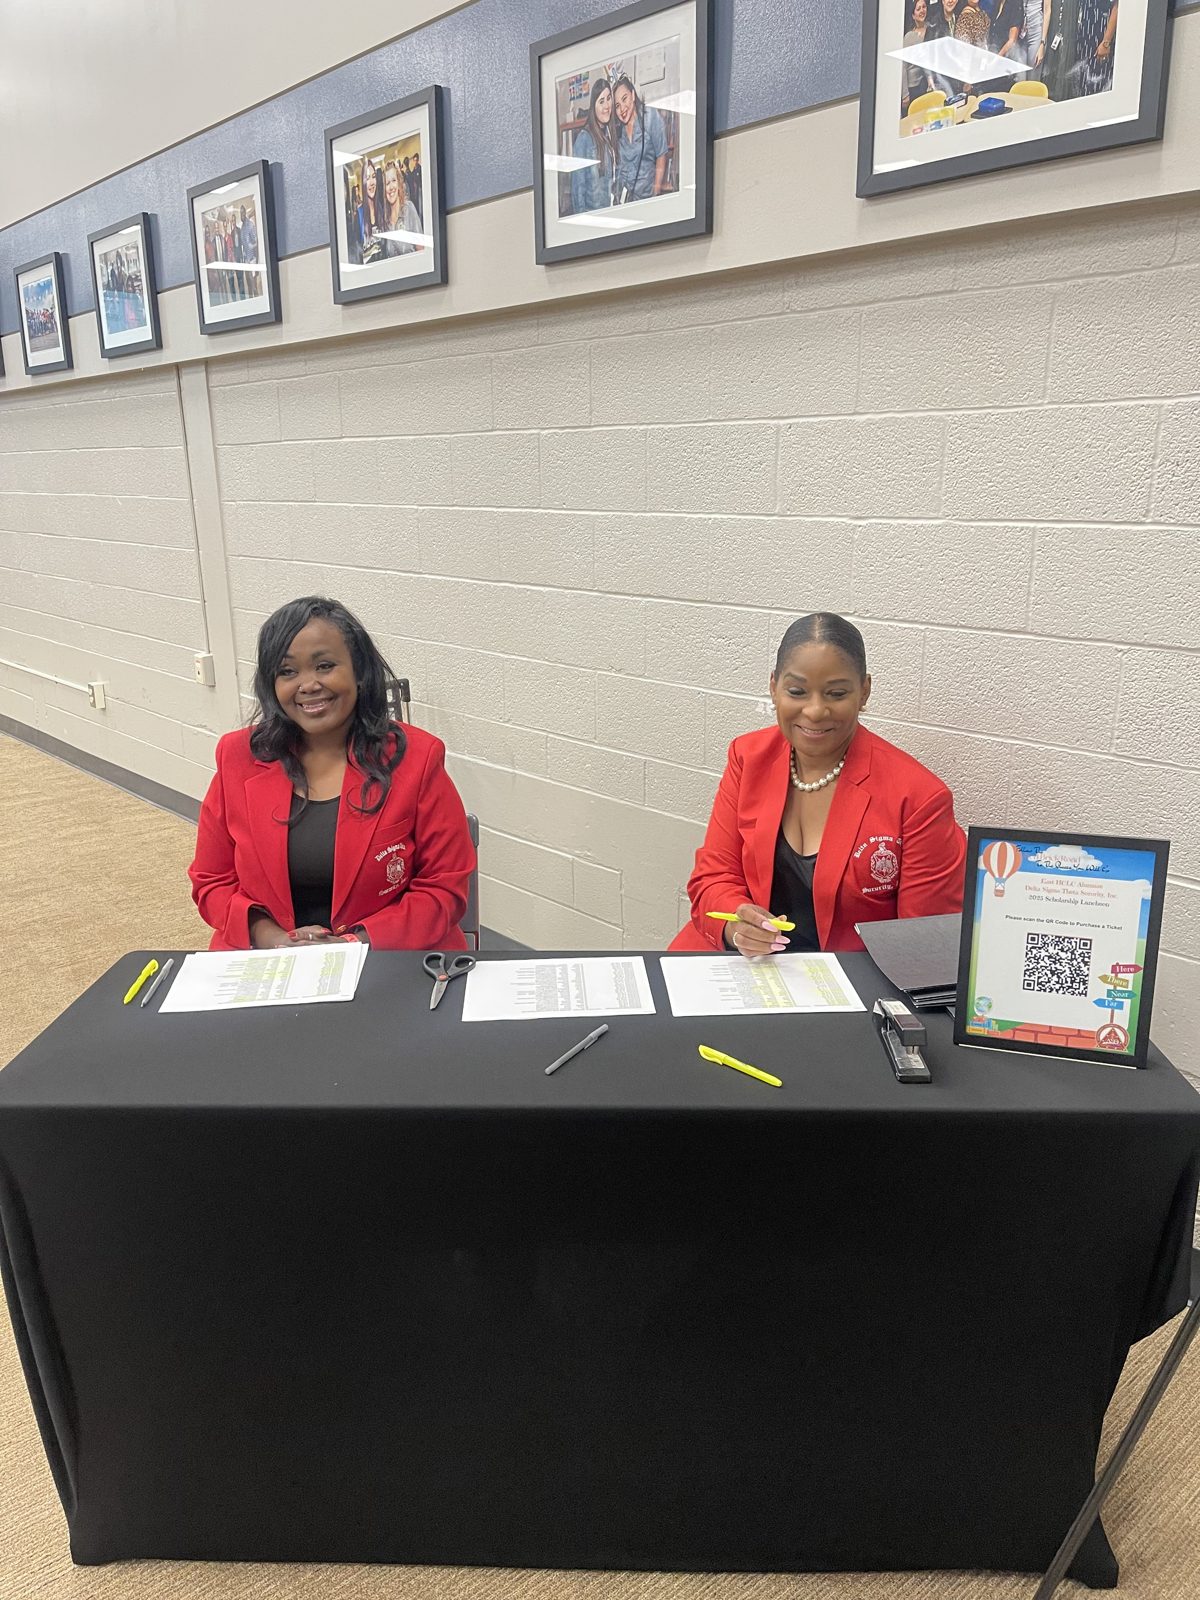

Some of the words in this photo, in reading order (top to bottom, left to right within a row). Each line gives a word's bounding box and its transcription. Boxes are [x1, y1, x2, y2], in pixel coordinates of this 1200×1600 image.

[1042, 886, 1060, 894] Sigma
[1045, 896, 1079, 906] Scholarship
[1080, 899, 1110, 908] Luncheon
[1076, 921, 1101, 929] Purchase
[1115, 965, 1135, 973] Here
[1107, 976, 1128, 987] There
[1110, 990, 1129, 998] Near
[1105, 999, 1118, 1007] Far
